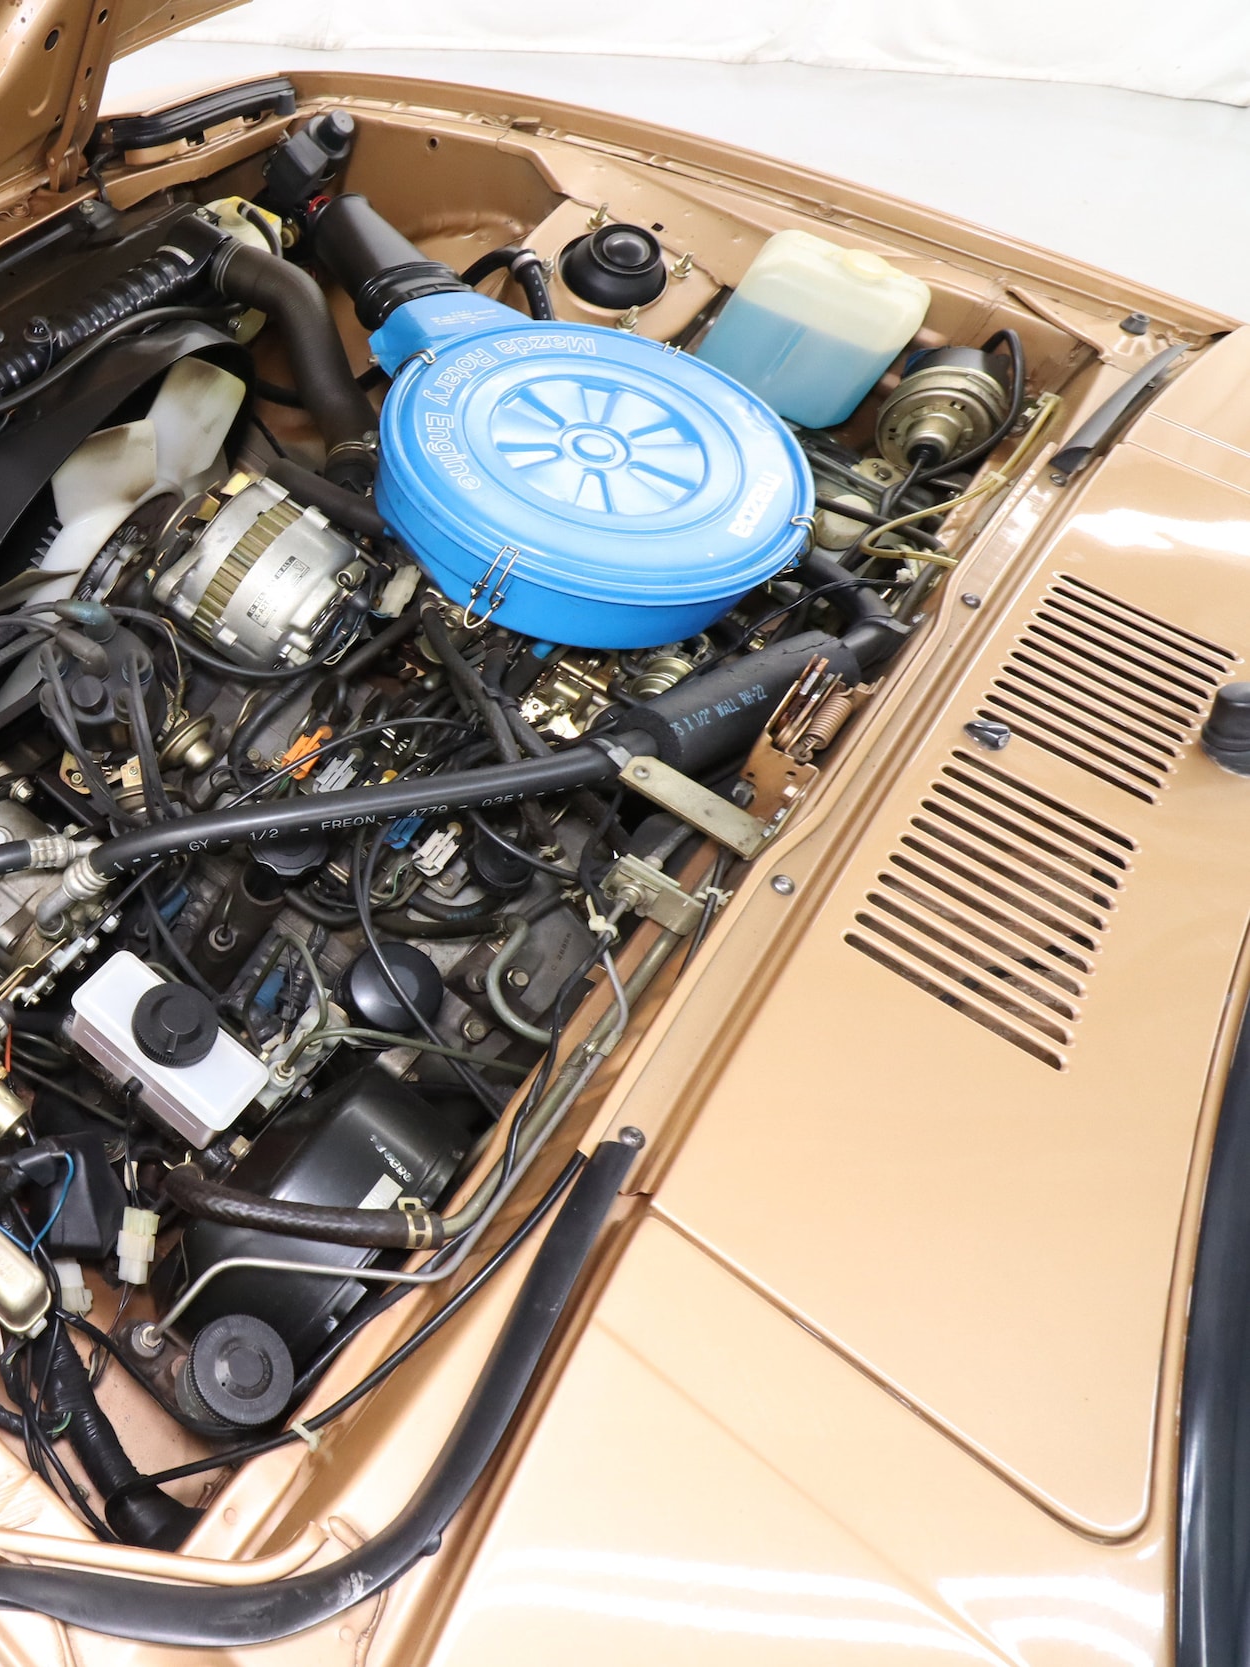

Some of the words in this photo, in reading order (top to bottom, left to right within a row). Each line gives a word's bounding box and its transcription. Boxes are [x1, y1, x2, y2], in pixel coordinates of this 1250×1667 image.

[493, 335, 597, 355] Mazda
[421, 348, 500, 407] Rotary
[424, 411, 481, 491] Engine
[727, 471, 784, 539] mazda
[187, 838, 210, 852] GY
[249, 824, 280, 844] 1/2
[320, 811, 377, 833] FREON
